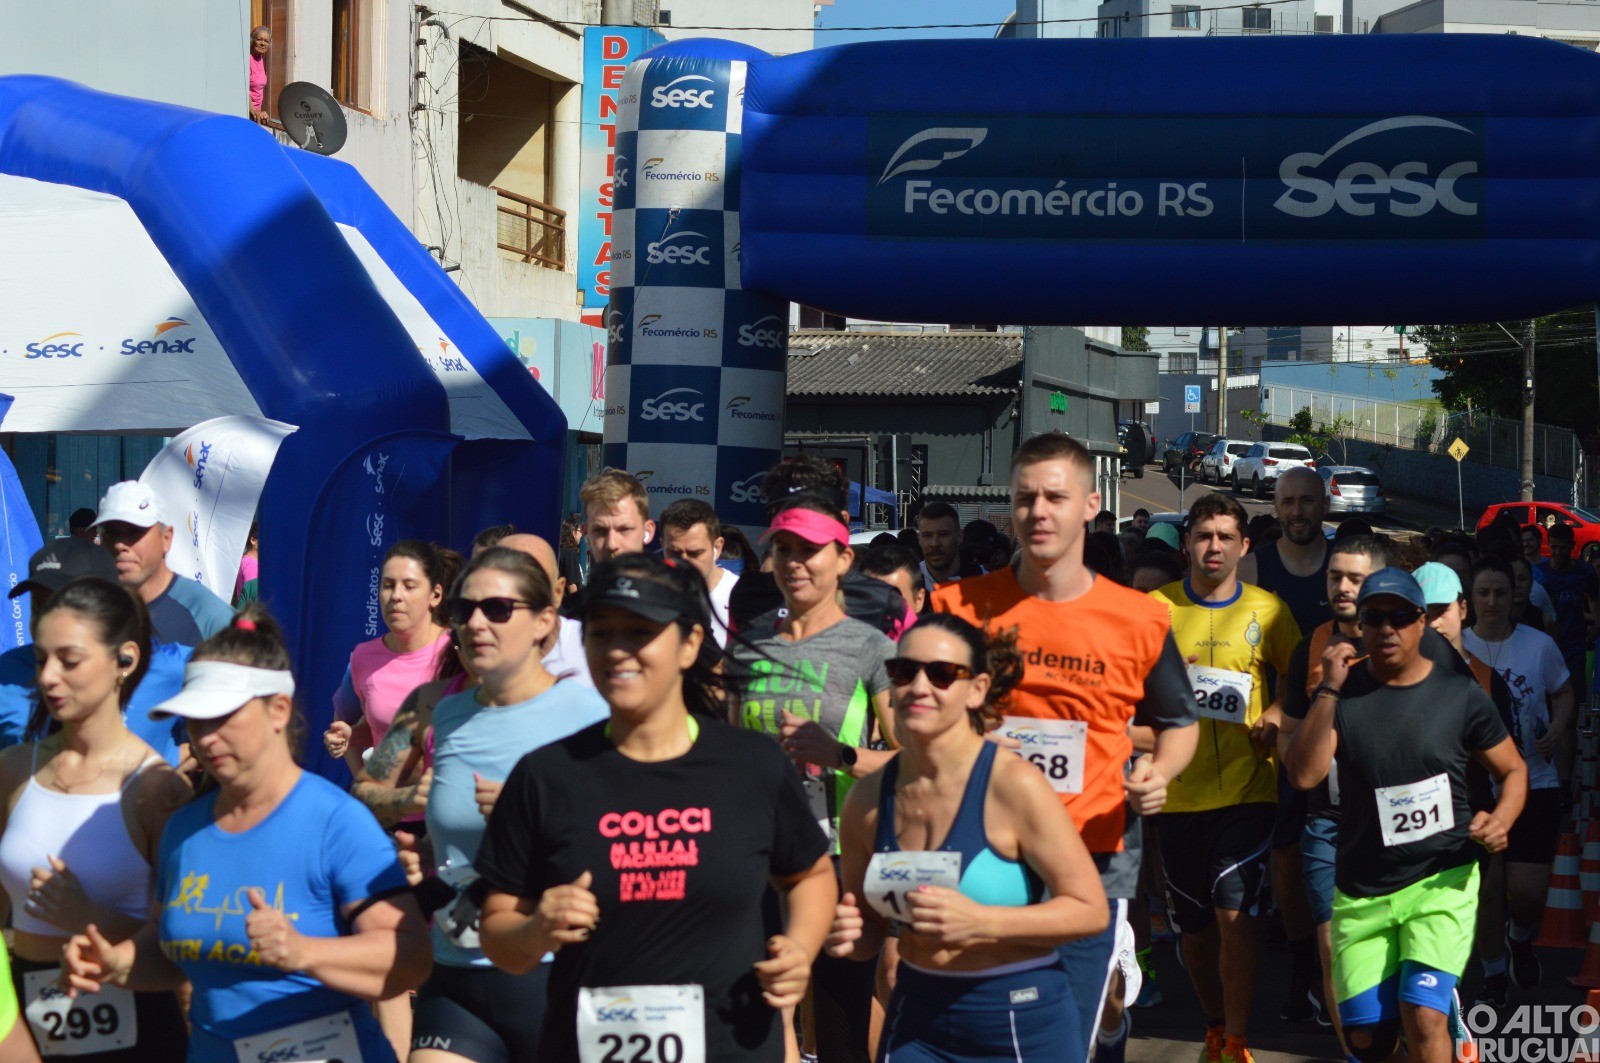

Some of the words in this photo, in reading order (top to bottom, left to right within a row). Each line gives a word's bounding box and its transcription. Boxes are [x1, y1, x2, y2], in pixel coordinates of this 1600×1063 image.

[646, 171, 701, 181] Fecomércio
[704, 172, 719, 182] RS
[1272, 152, 1478, 218] Sesc
[904, 180, 1144, 216] Fecomércio
[1158, 182, 1214, 217] RS
[646, 242, 710, 264] Sesc
[642, 327, 700, 338] Fecomércio
[703, 329, 718, 338] RS
[120, 338, 196, 355] Senac
[640, 399, 704, 422] Sesc
[732, 410, 776, 420] Fecomércio
[646, 484, 692, 494] comércio
[696, 486, 710, 495] RS
[366, 566, 380, 636] Sindicatos
[1022, 647, 1106, 675] demia
[1194, 690, 1238, 713] 288
[1016, 753, 1068, 780] 68
[598, 807, 712, 839] COLCCI
[1392, 804, 1439, 834] 291
[44, 1003, 119, 1041] 299
[598, 1033, 684, 1063] 220
